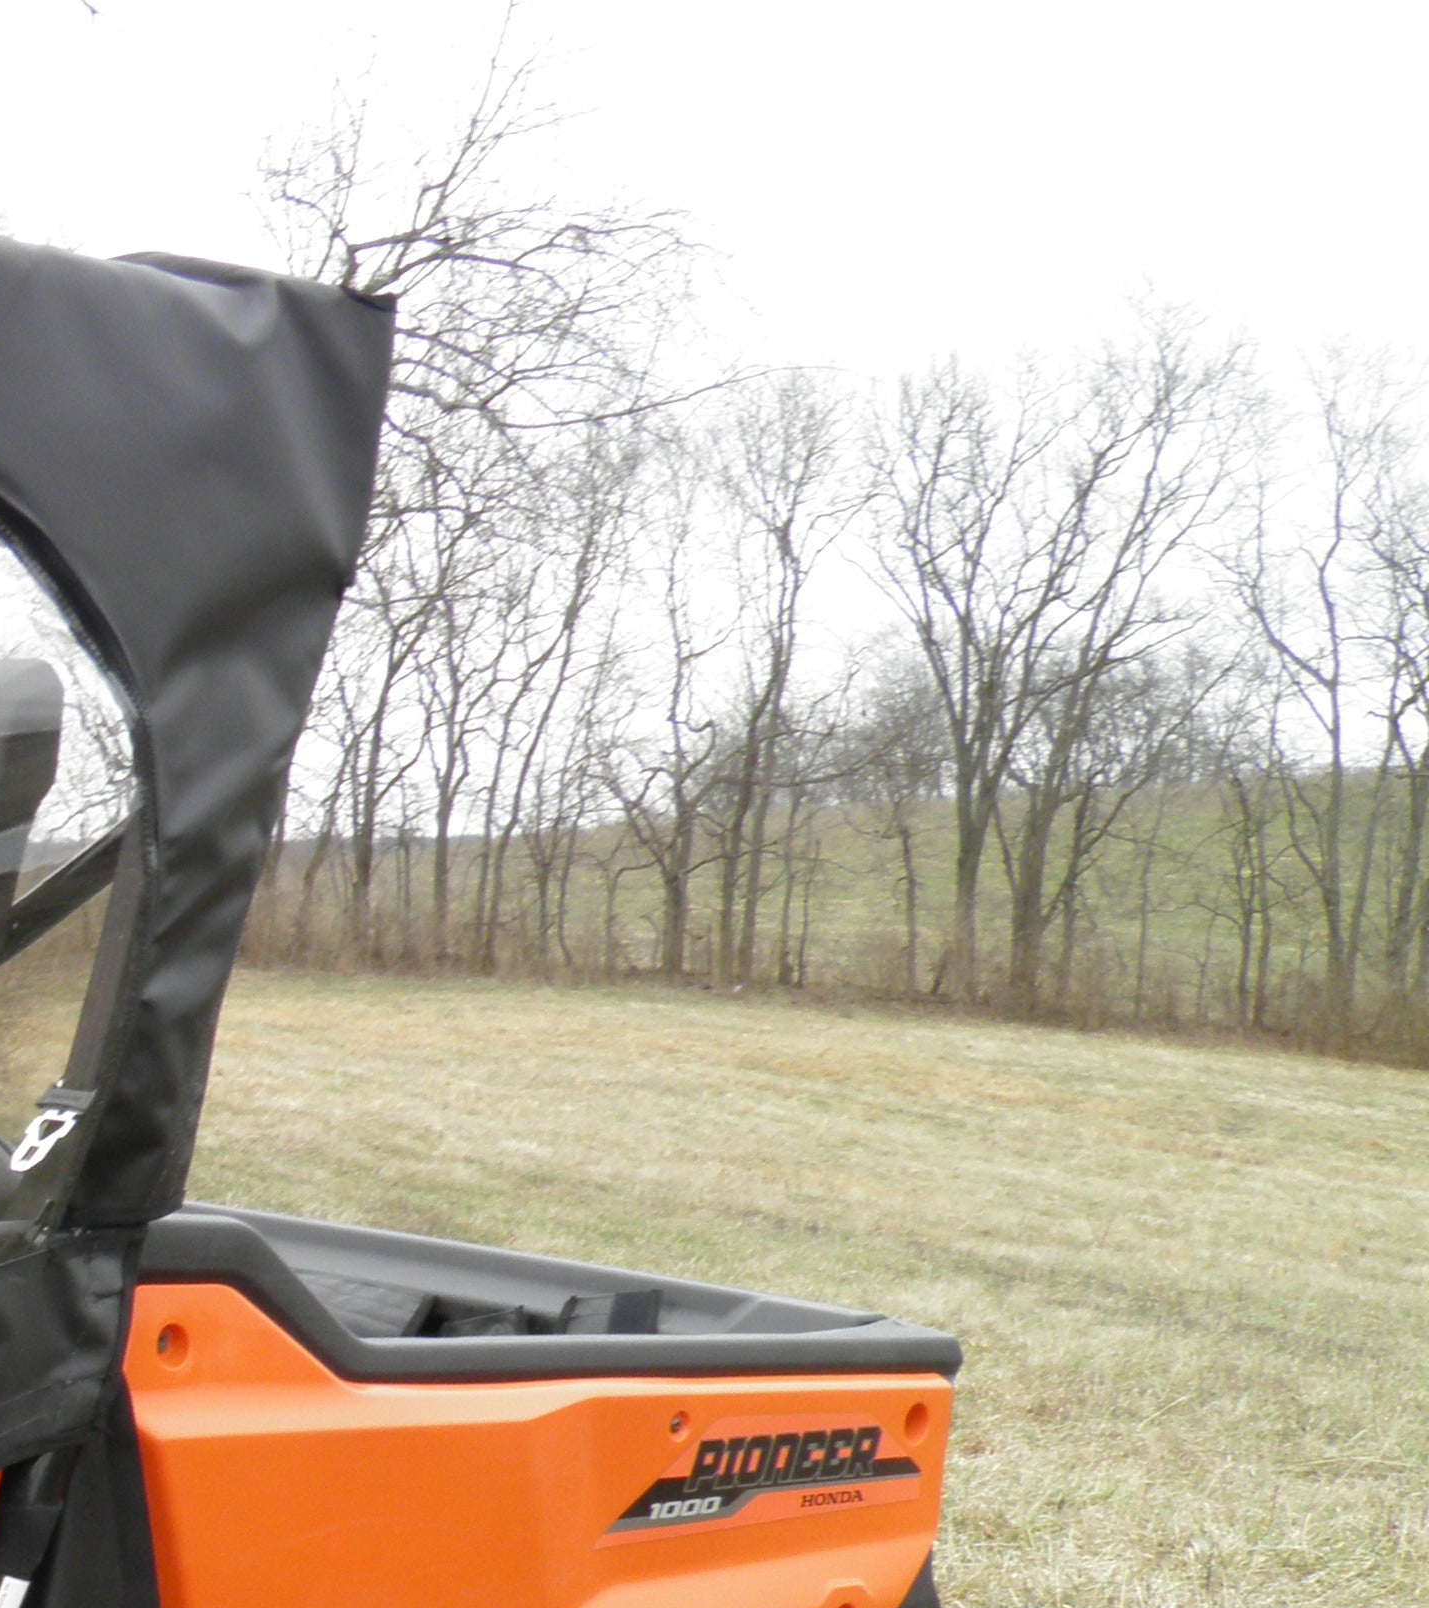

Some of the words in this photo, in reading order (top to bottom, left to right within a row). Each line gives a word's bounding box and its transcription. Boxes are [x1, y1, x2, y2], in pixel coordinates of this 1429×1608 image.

[683, 1425, 883, 1492] PIONEER
[648, 1496, 722, 1520] 1000
[800, 1489, 863, 1508] HONDA
